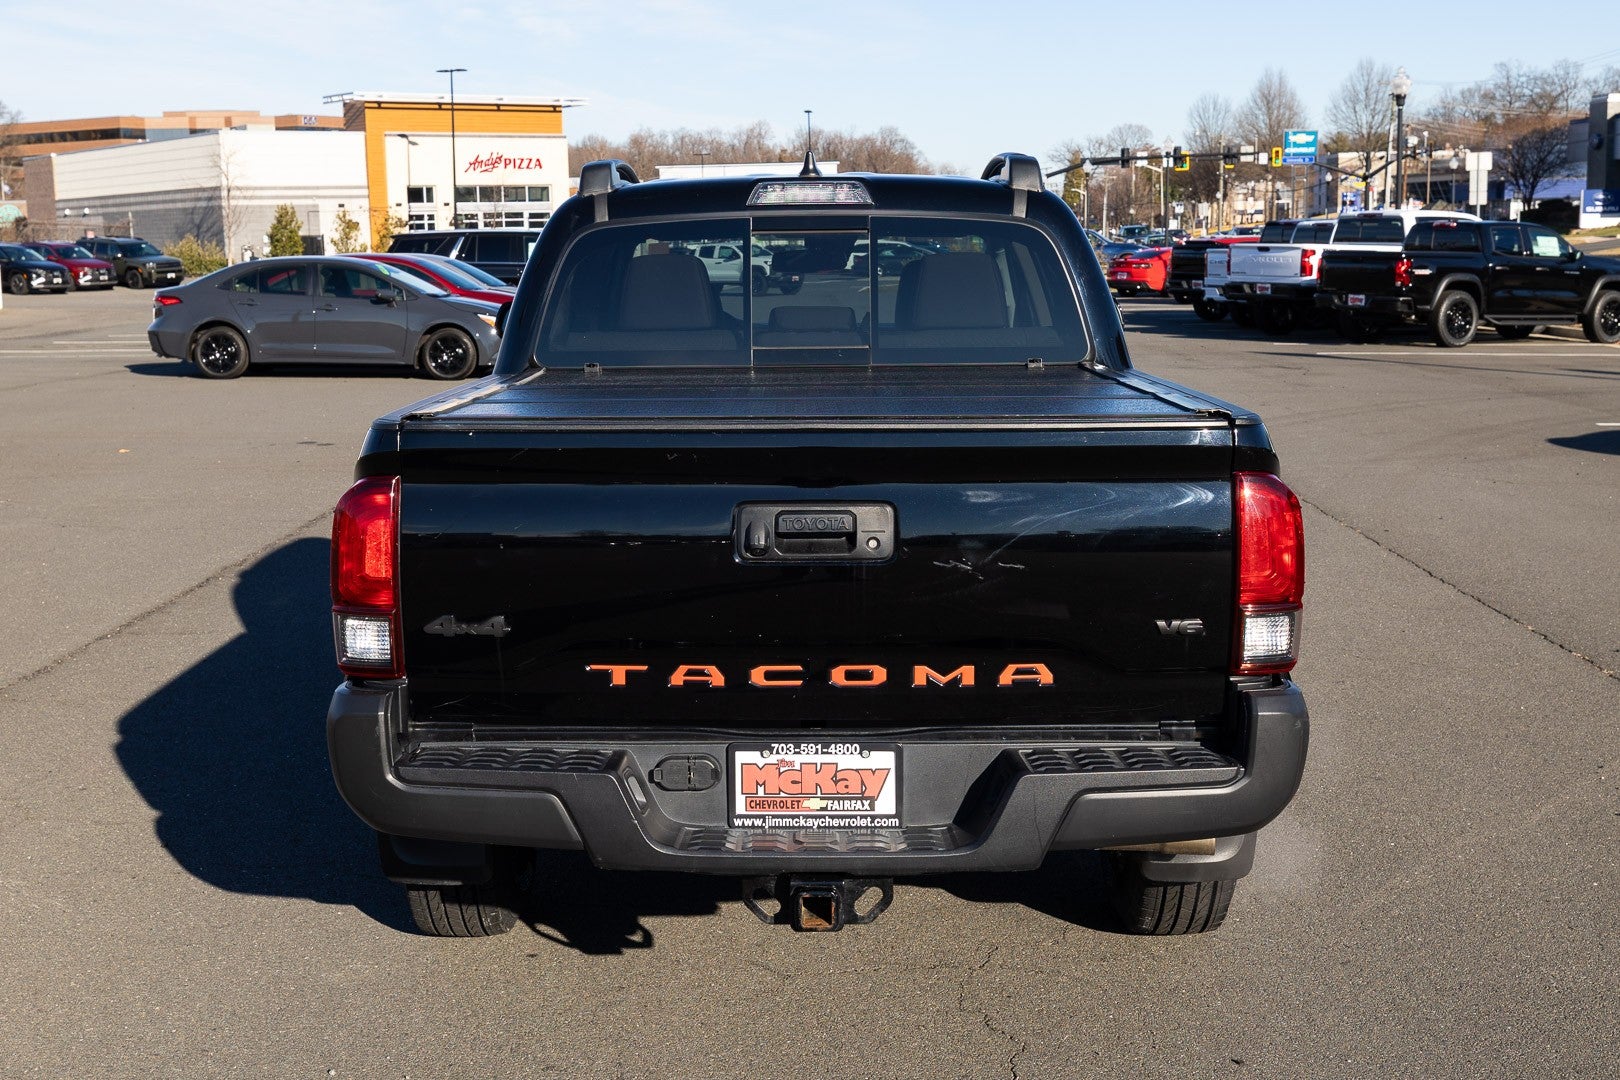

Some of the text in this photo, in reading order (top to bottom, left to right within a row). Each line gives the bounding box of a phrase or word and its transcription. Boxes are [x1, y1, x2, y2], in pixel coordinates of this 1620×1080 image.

[464, 152, 543, 173] Andy's PIZZA
[782, 517, 850, 531] TOYOTA
[1155, 618, 1203, 634] V6
[585, 664, 1055, 687] TACOMA
[771, 743, 861, 755] 703-591-4800
[741, 762, 891, 801] McKay
[749, 799, 871, 811] CHEVROLET FAIRFAX
[733, 816, 899, 829] www.jimmckaychevrolet.com
